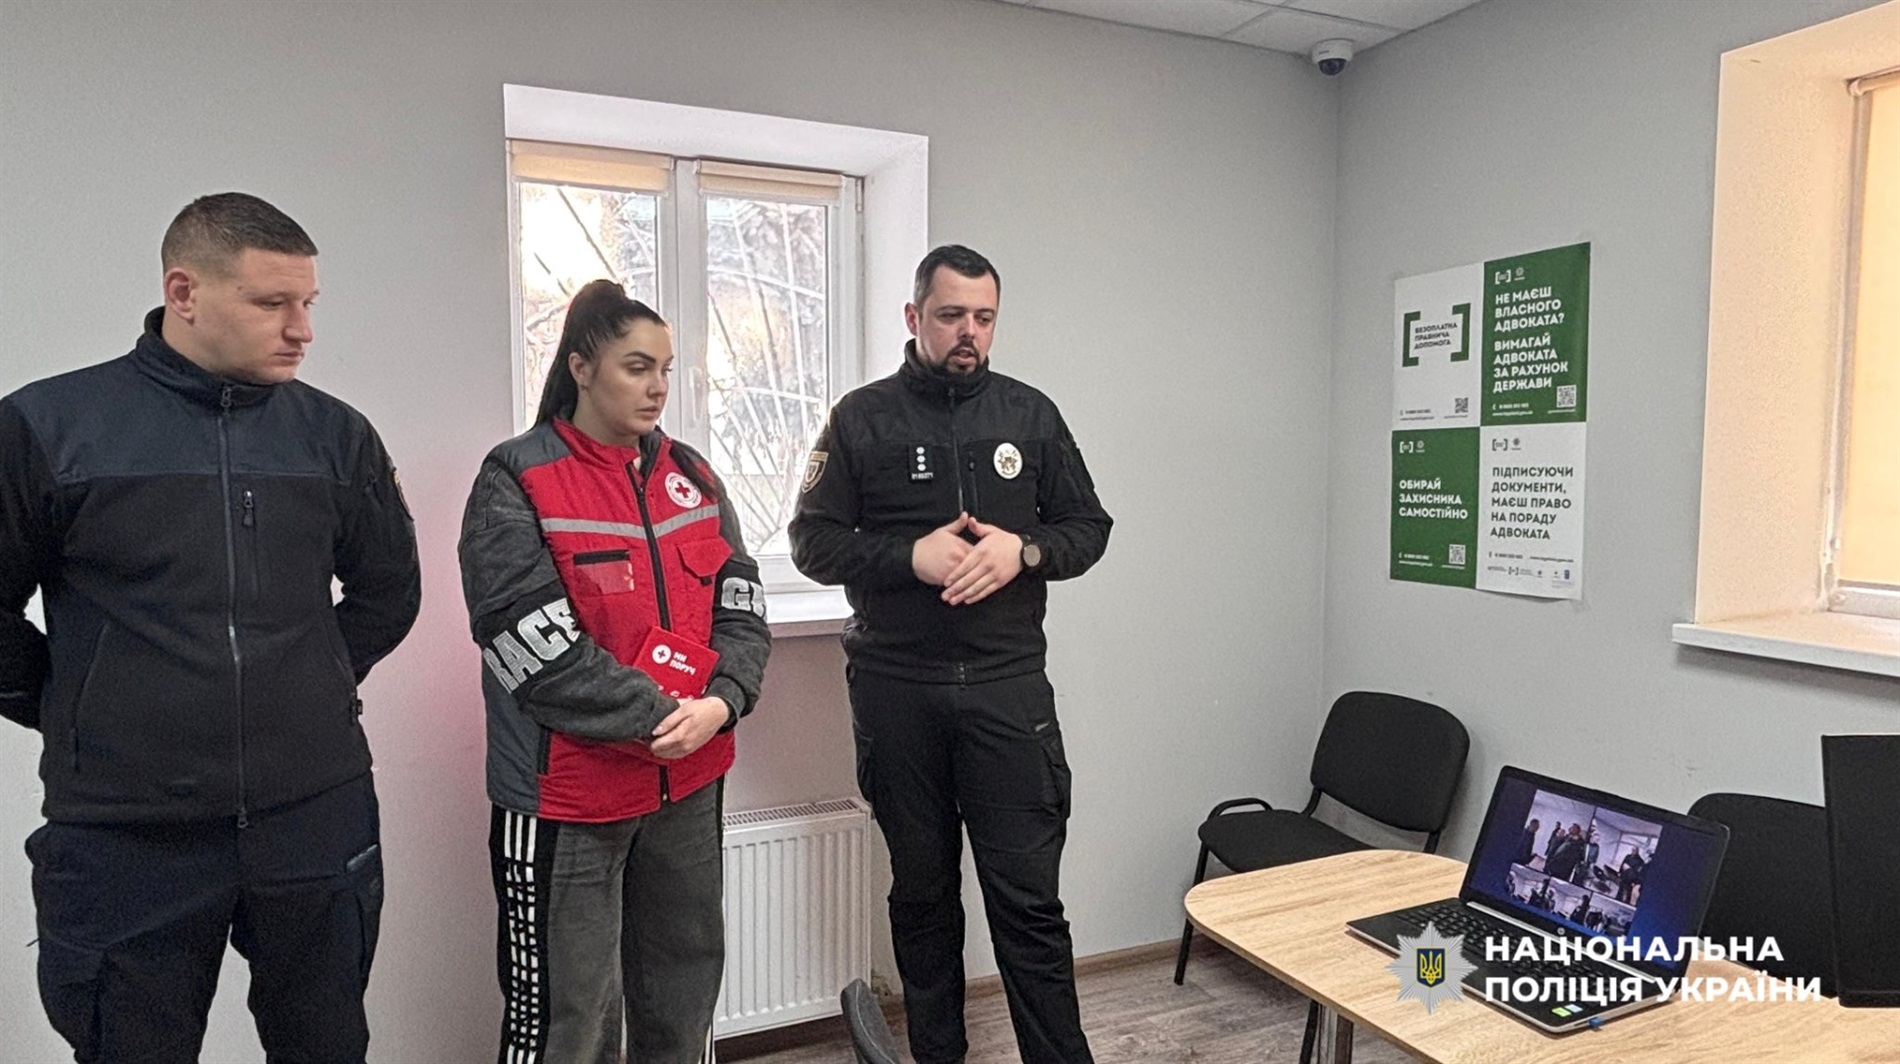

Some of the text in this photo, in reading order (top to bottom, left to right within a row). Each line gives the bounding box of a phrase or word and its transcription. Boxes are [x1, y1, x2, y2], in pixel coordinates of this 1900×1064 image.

[1495, 286, 1552, 305] НЕ МАЄШ
[1495, 299, 1561, 318] ВЛАСНОГО
[1414, 322, 1458, 334] БЕЗОПЛАТНА
[1494, 312, 1565, 332] АДВОКАТА?
[1414, 332, 1450, 341] ПРАВНИЧА
[1494, 333, 1551, 351] ВИМАГАЙ
[1414, 339, 1451, 350] ДОПОМОГА
[1493, 348, 1558, 366] АДВОКАТА
[1493, 361, 1568, 378] ЗА РАХУНОК
[1493, 377, 1552, 394] ДЕРЖАВИ
[1492, 466, 1574, 479] ПІДПИСУЮЧИ
[1399, 477, 1441, 490] ОБИРАЙ
[1491, 482, 1567, 494] ДОКУМЕНТИ,
[1399, 493, 1462, 505] ЗАХИСНИКА
[1491, 497, 1572, 509] МАЄШ ПРАВО
[1399, 506, 1468, 519] САМОСТІЙНО
[1491, 512, 1557, 525] НА ПОРАДУ
[1490, 527, 1551, 540] АДВОКАТА
[673, 651, 688, 662] МИ
[669, 659, 697, 676] ПОРУЧ
